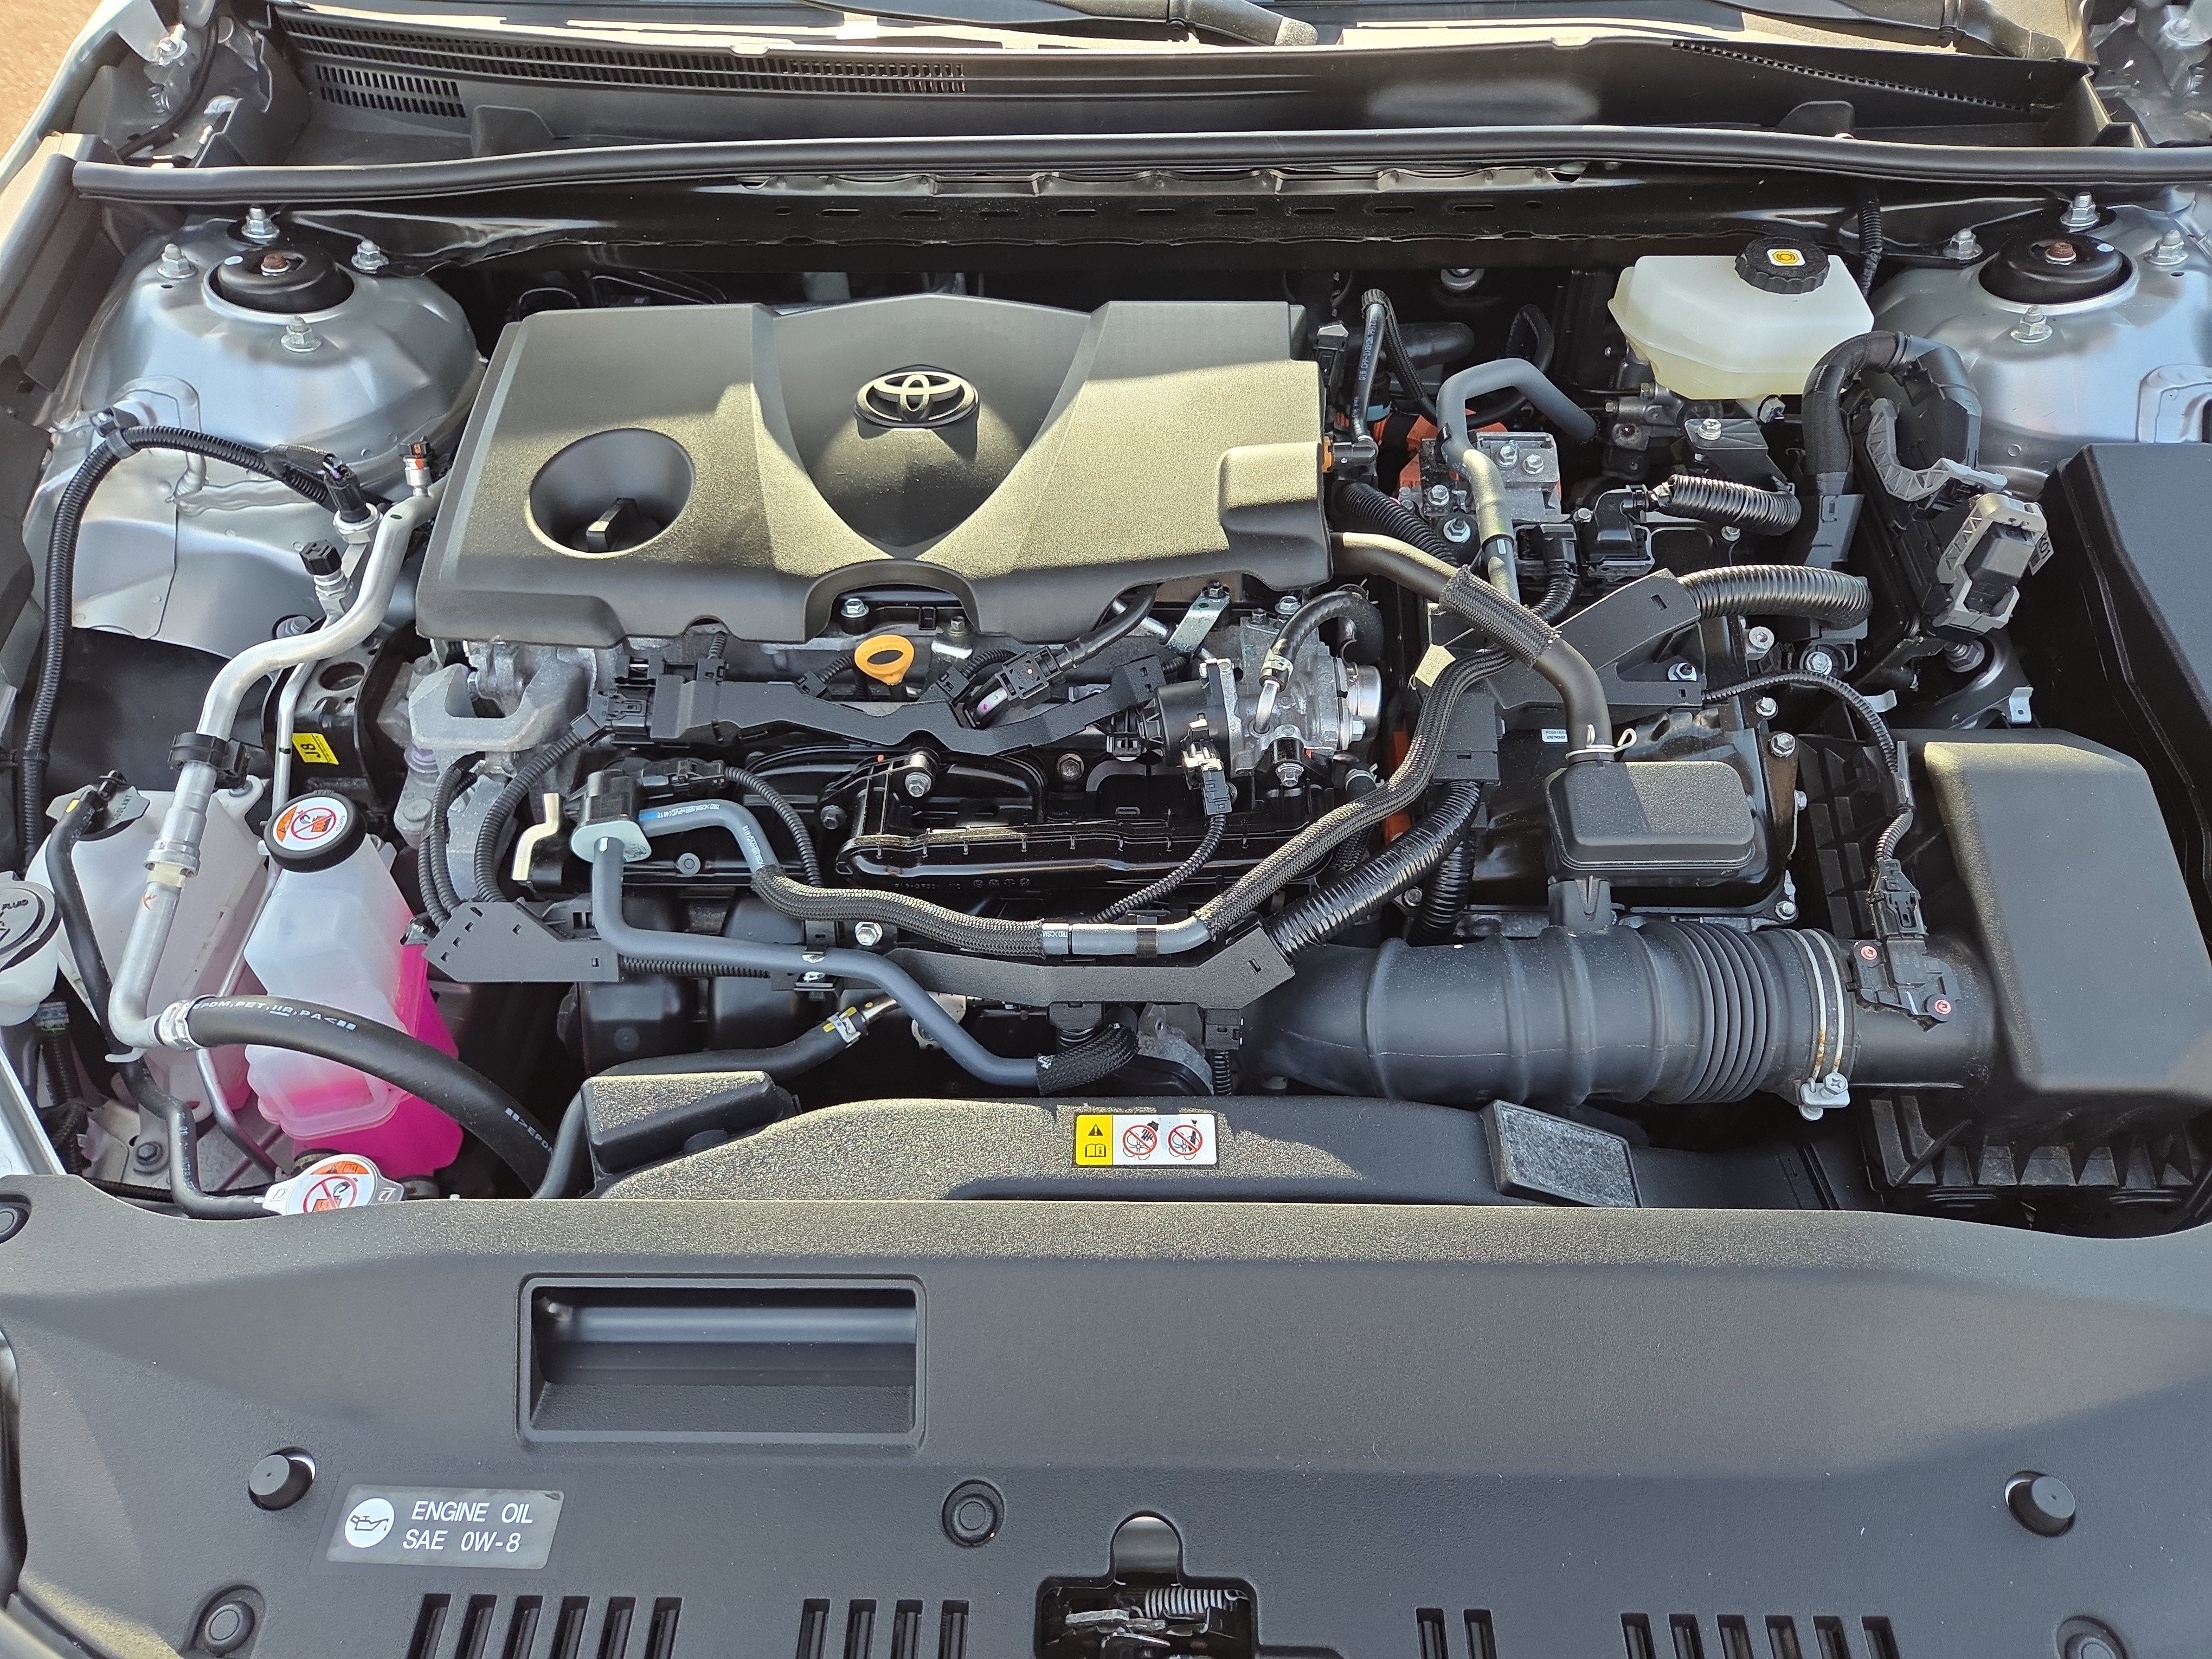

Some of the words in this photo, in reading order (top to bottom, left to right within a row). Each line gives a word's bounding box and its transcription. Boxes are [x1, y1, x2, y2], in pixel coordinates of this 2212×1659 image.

[410, 1500, 490, 1522] ENGINE
[500, 1503, 534, 1525] OIL
[402, 1528, 448, 1551] SAE
[461, 1531, 522, 1553] 0W-8
